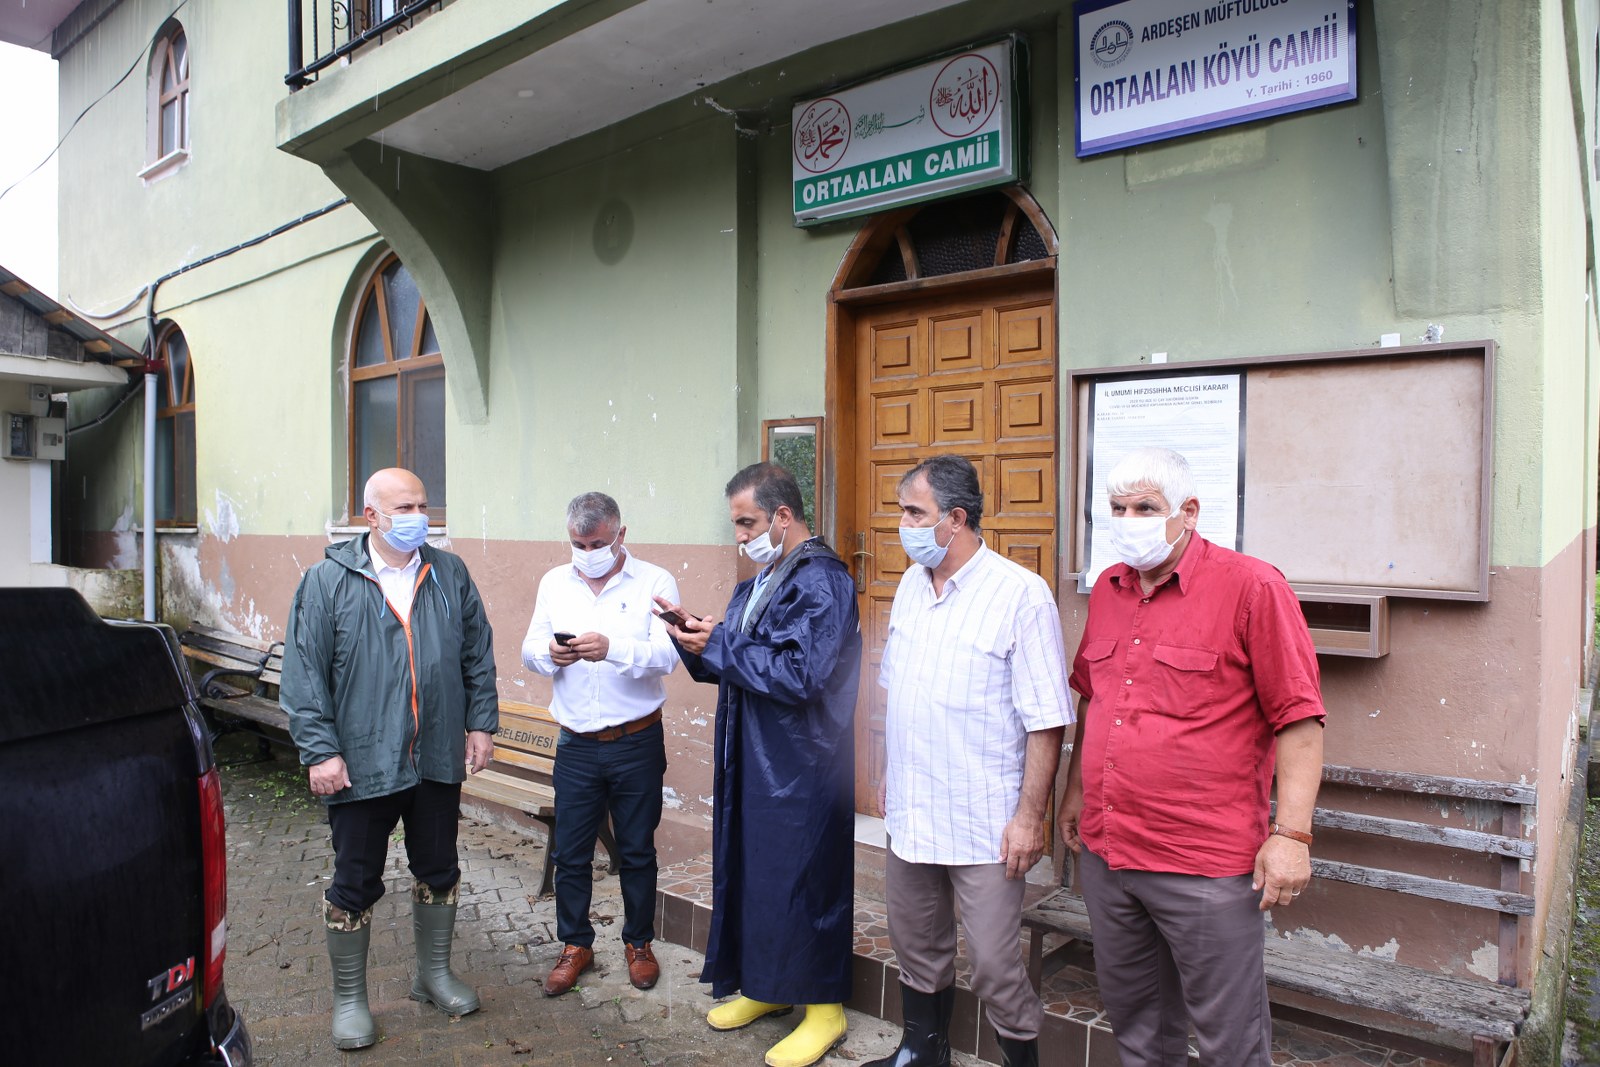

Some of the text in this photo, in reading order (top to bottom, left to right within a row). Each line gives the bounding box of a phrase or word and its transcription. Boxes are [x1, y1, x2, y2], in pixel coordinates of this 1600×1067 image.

[1141, 0, 1288, 43] ARDEŞEN MÜFTÜL
[1090, 59, 1196, 117] ORTAALAN
[1203, 34, 1260, 90] KÖYÜ
[1246, 88, 1257, 99] Y.
[1260, 79, 1293, 97] Tarihi
[1304, 70, 1333, 86] 1960
[802, 159, 913, 205] ORTAALAN
[1202, 383, 1229, 392] KARARI
[496, 726, 554, 750] BELEDİYESİ
[147, 956, 195, 1001] TDI
